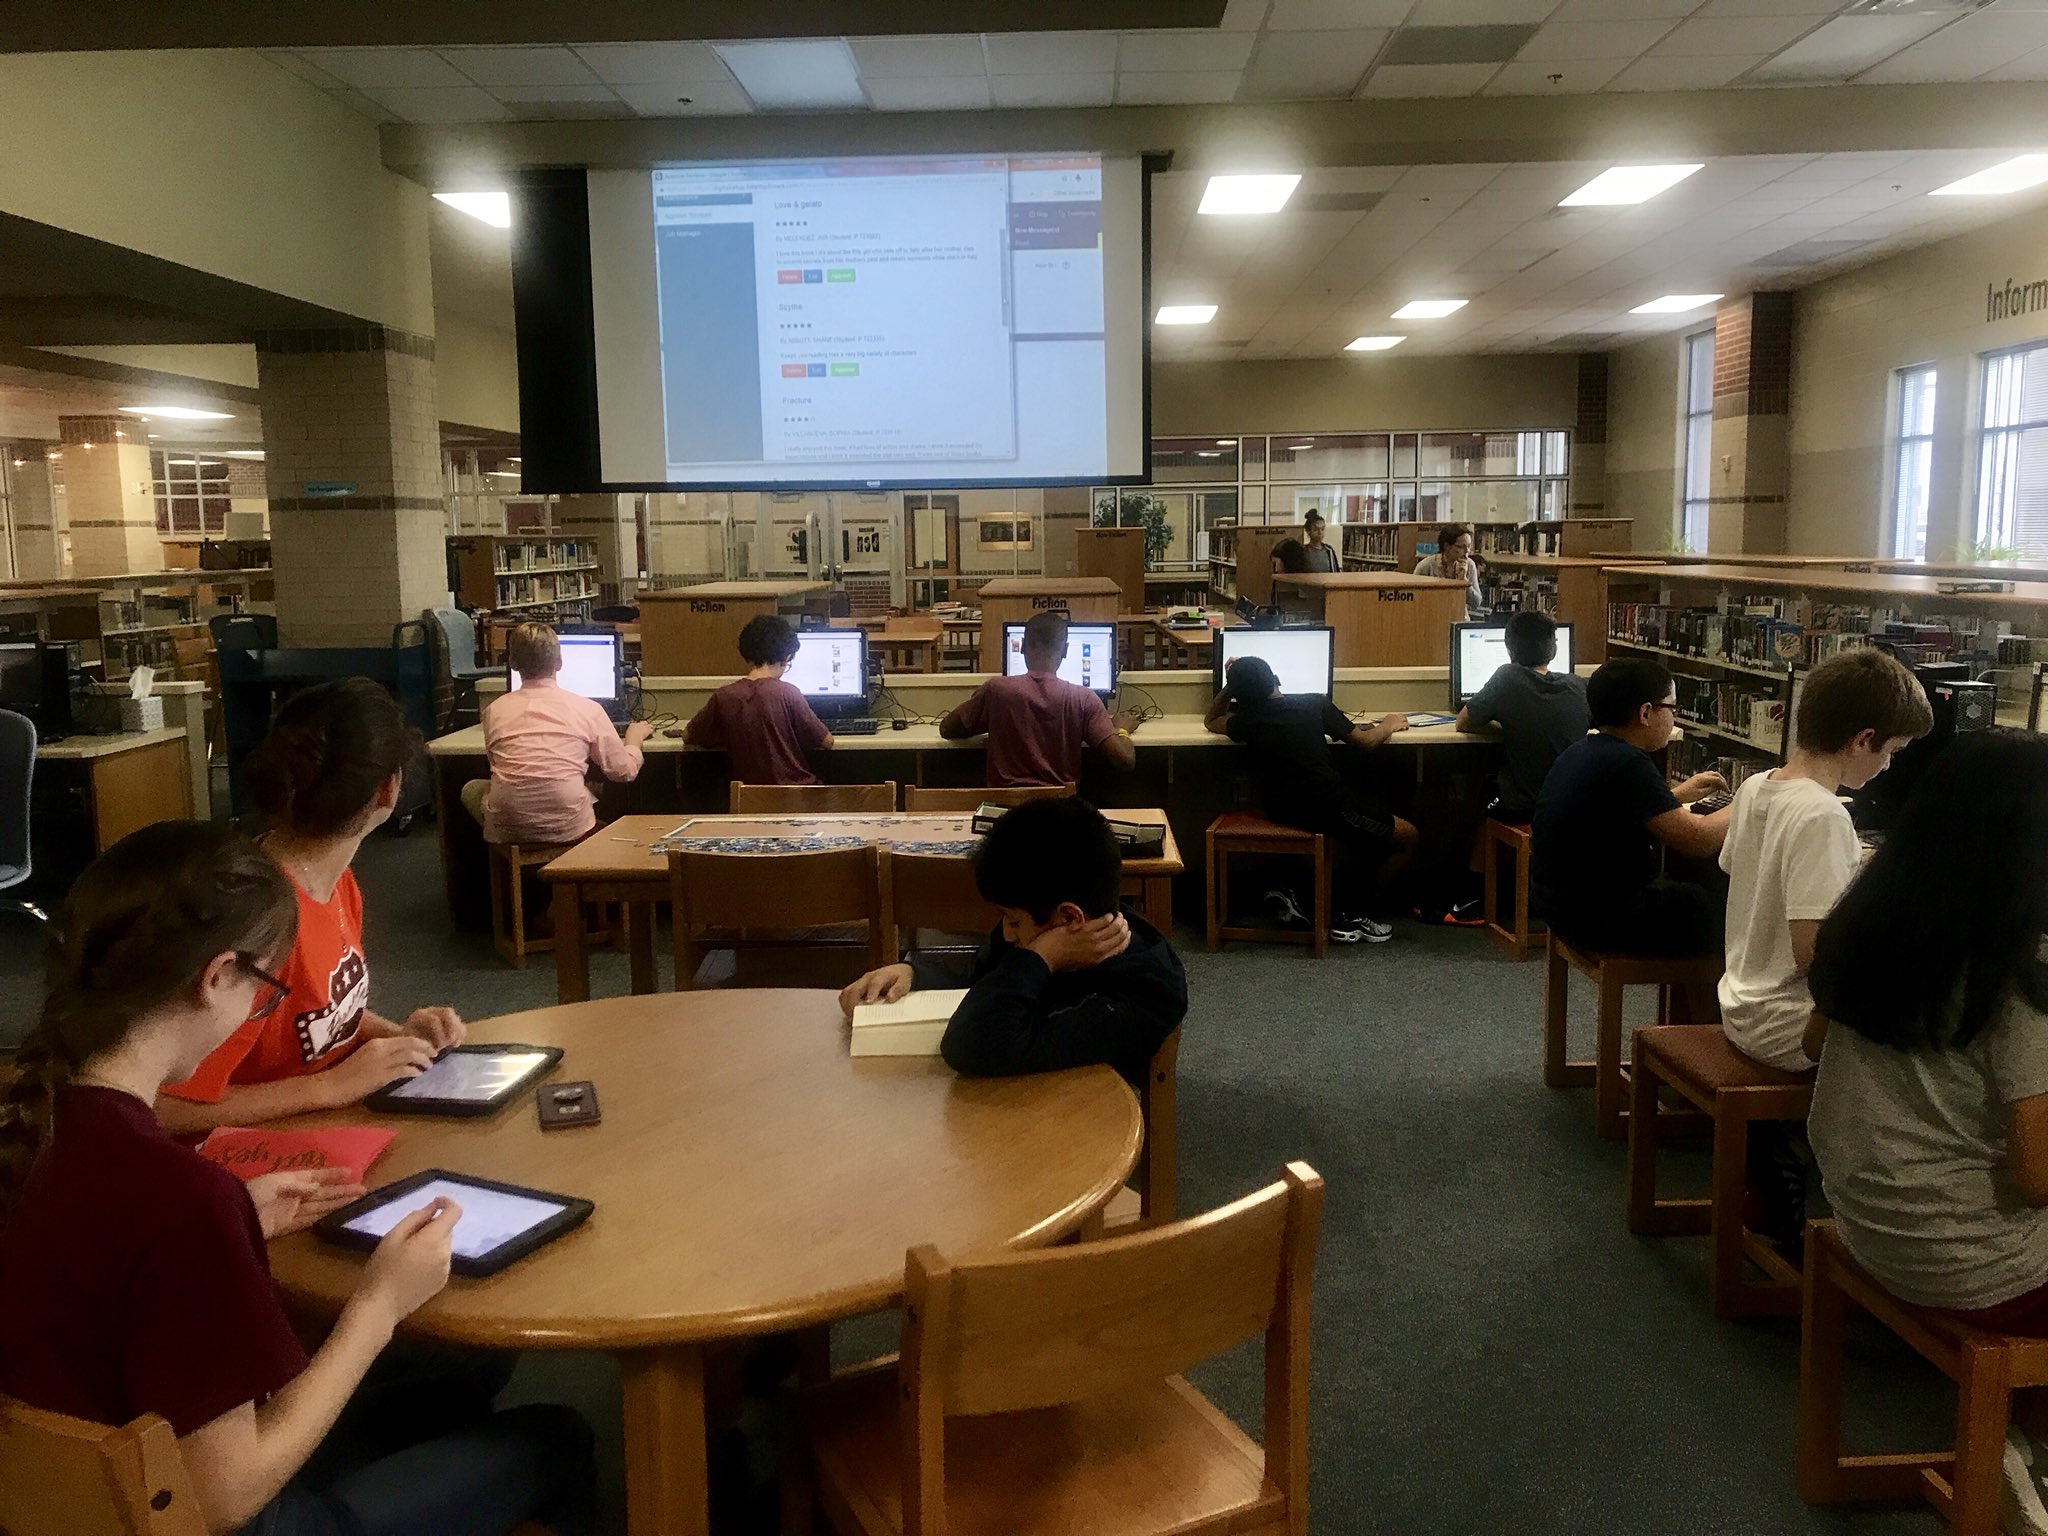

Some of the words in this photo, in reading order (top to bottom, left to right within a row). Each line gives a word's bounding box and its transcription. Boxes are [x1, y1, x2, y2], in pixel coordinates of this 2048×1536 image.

[774, 200, 792, 209] Love
[778, 302, 803, 312] Scythe
[782, 395, 812, 405] Fracture
[1378, 589, 1414, 602] Fiction
[690, 600, 726, 613] Fiction
[1032, 596, 1067, 610] Fiction
